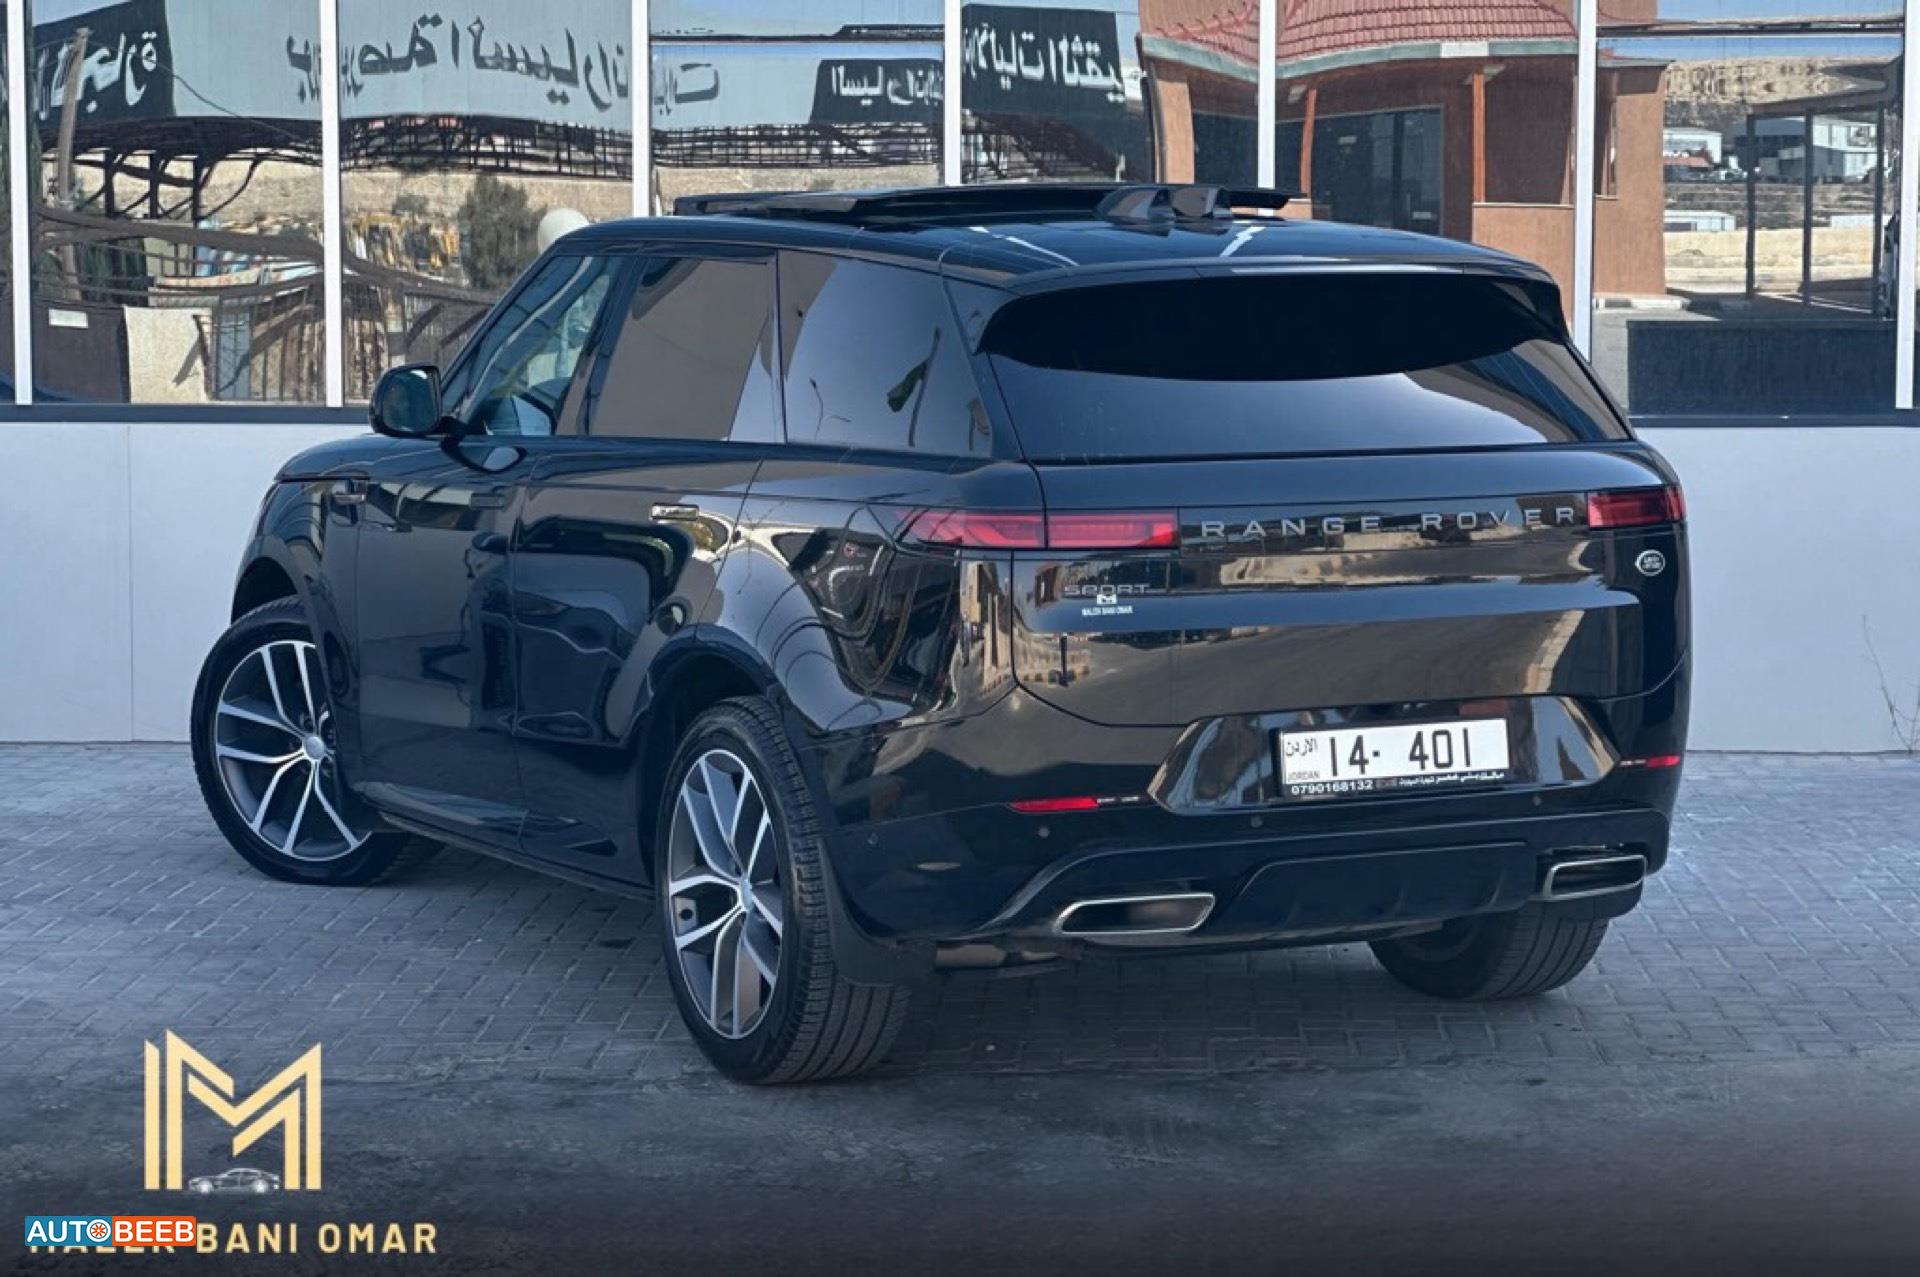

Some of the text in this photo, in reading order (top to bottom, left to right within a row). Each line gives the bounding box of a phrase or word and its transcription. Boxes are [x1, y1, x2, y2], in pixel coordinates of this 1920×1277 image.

[1201, 506, 1574, 538] RANGE ROVER
[1064, 584, 1150, 596] SPORT
[1408, 727, 1471, 770] 401
